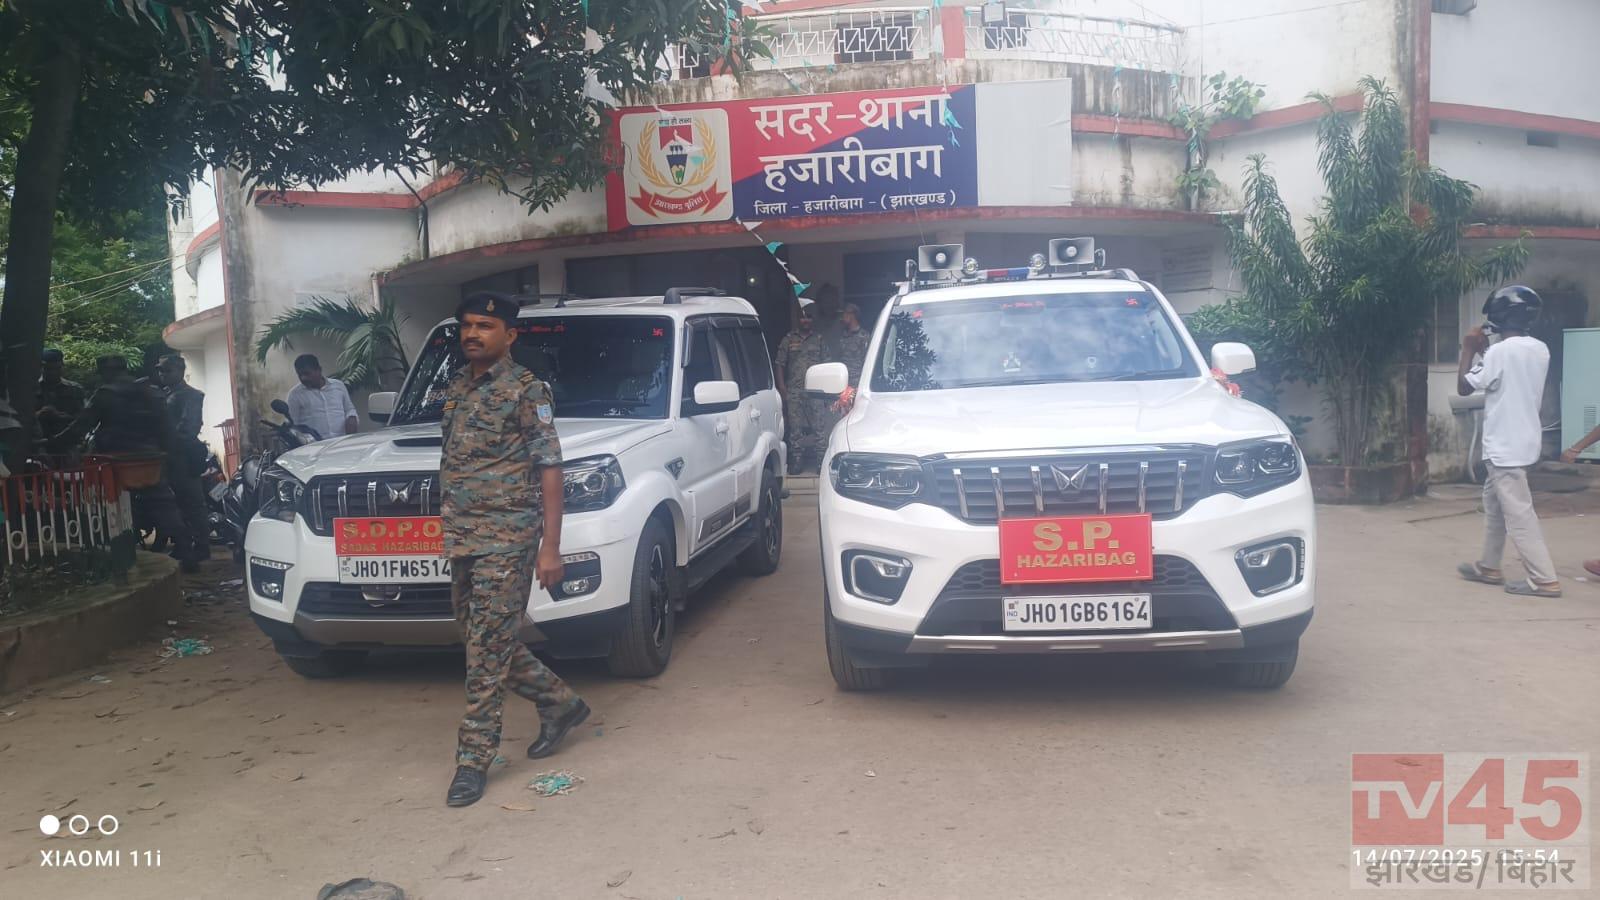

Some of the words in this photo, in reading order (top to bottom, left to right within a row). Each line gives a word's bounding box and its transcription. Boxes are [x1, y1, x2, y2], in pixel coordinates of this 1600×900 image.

[758, 136, 944, 192] हजारीबाग
[754, 199, 787, 215] जिला
[803, 194, 864, 213] हजारीबाग
[1032, 520, 1120, 551] S.P.
[1017, 551, 1136, 568] HAZARIBAG
[1020, 601, 1148, 624] JH01GB6164
